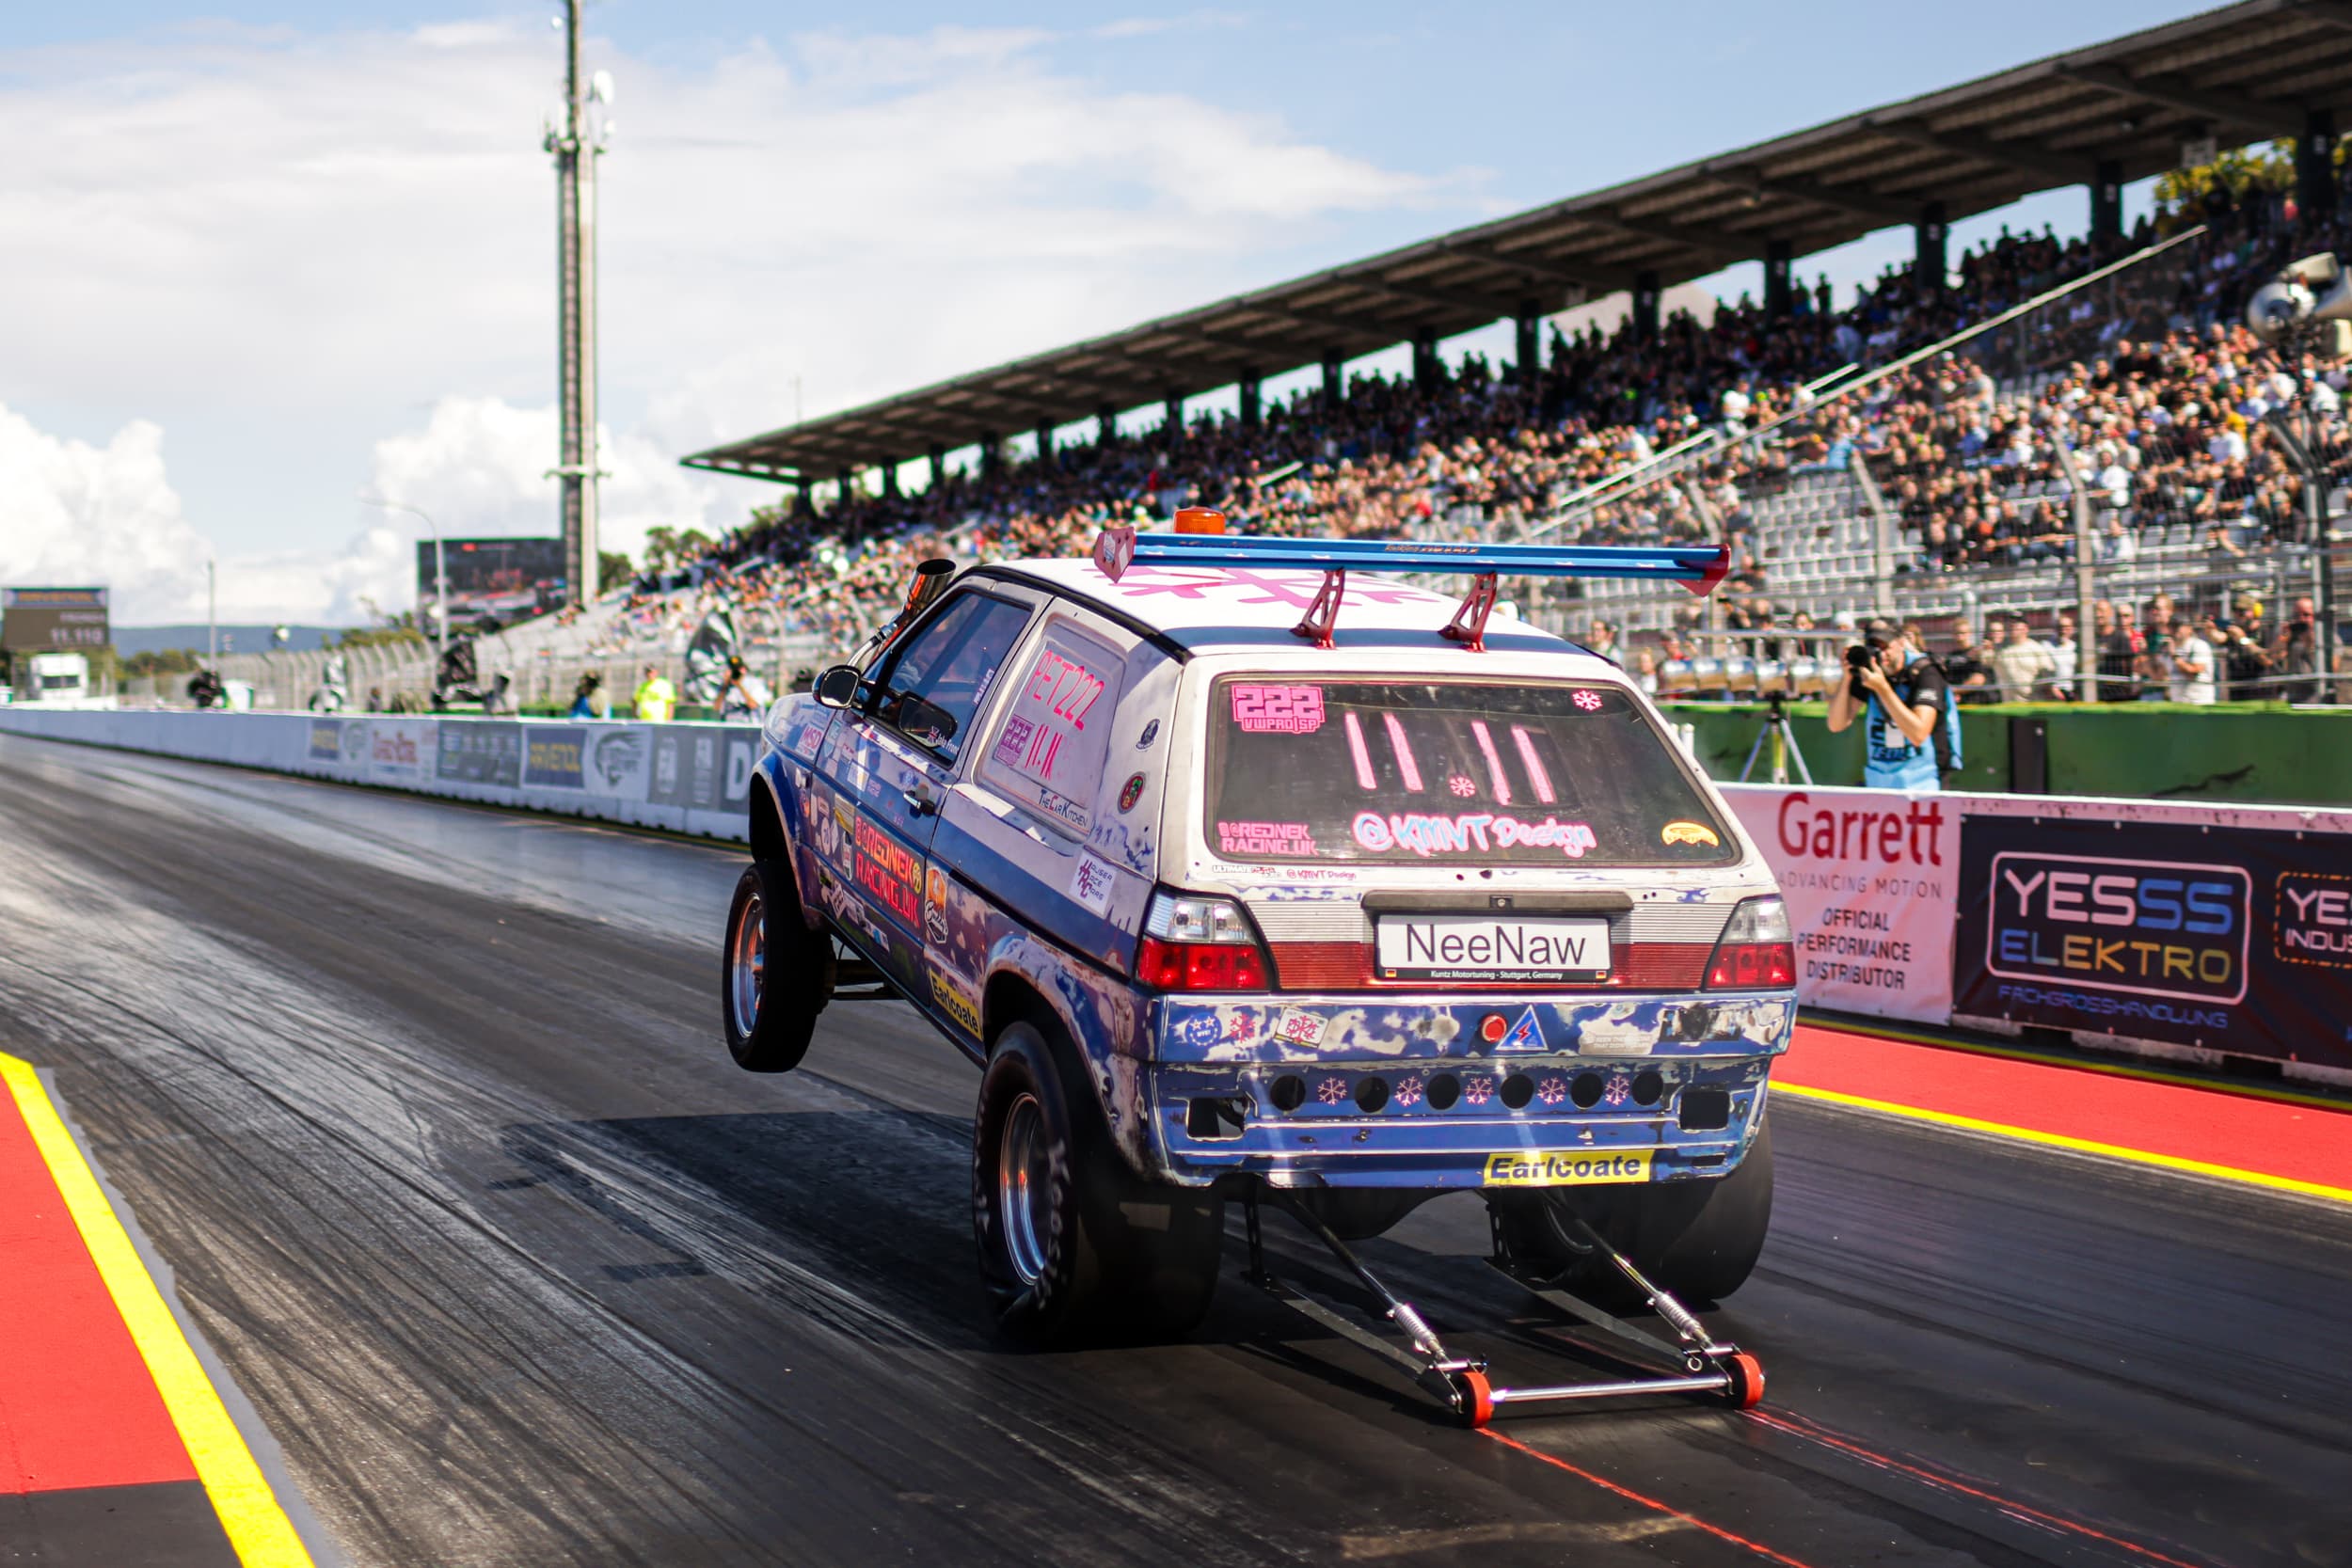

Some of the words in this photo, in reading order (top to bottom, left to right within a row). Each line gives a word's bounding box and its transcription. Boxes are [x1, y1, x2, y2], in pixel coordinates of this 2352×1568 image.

[1232, 686, 1323, 721] 222
[1491, 817, 1597, 858] Design
[1777, 792, 1943, 866] Garrett
[1777, 872, 1867, 894] ADVANCING
[1875, 879, 1943, 900] MOTION
[2004, 868, 2233, 935] YESSS
[1822, 908, 1890, 931] OFFICIAL
[2286, 888, 2352, 926] YE
[1406, 923, 1587, 965] NeeNaw
[1797, 933, 1912, 962] PERFORMANCE
[1999, 928, 2232, 983] ELEKTRO
[1430, 970, 1451, 978] Kuntz
[1452, 971, 1496, 980] Motortuning
[1532, 971, 1564, 980] Germany
[1806, 960, 1905, 990] DISTRIBUTOR
[931, 975, 978, 1033] Earlcoate
[1997, 985, 2229, 1028] FACHGROSSHANDLUNG
[1490, 1155, 1641, 1180] Earlcoate
